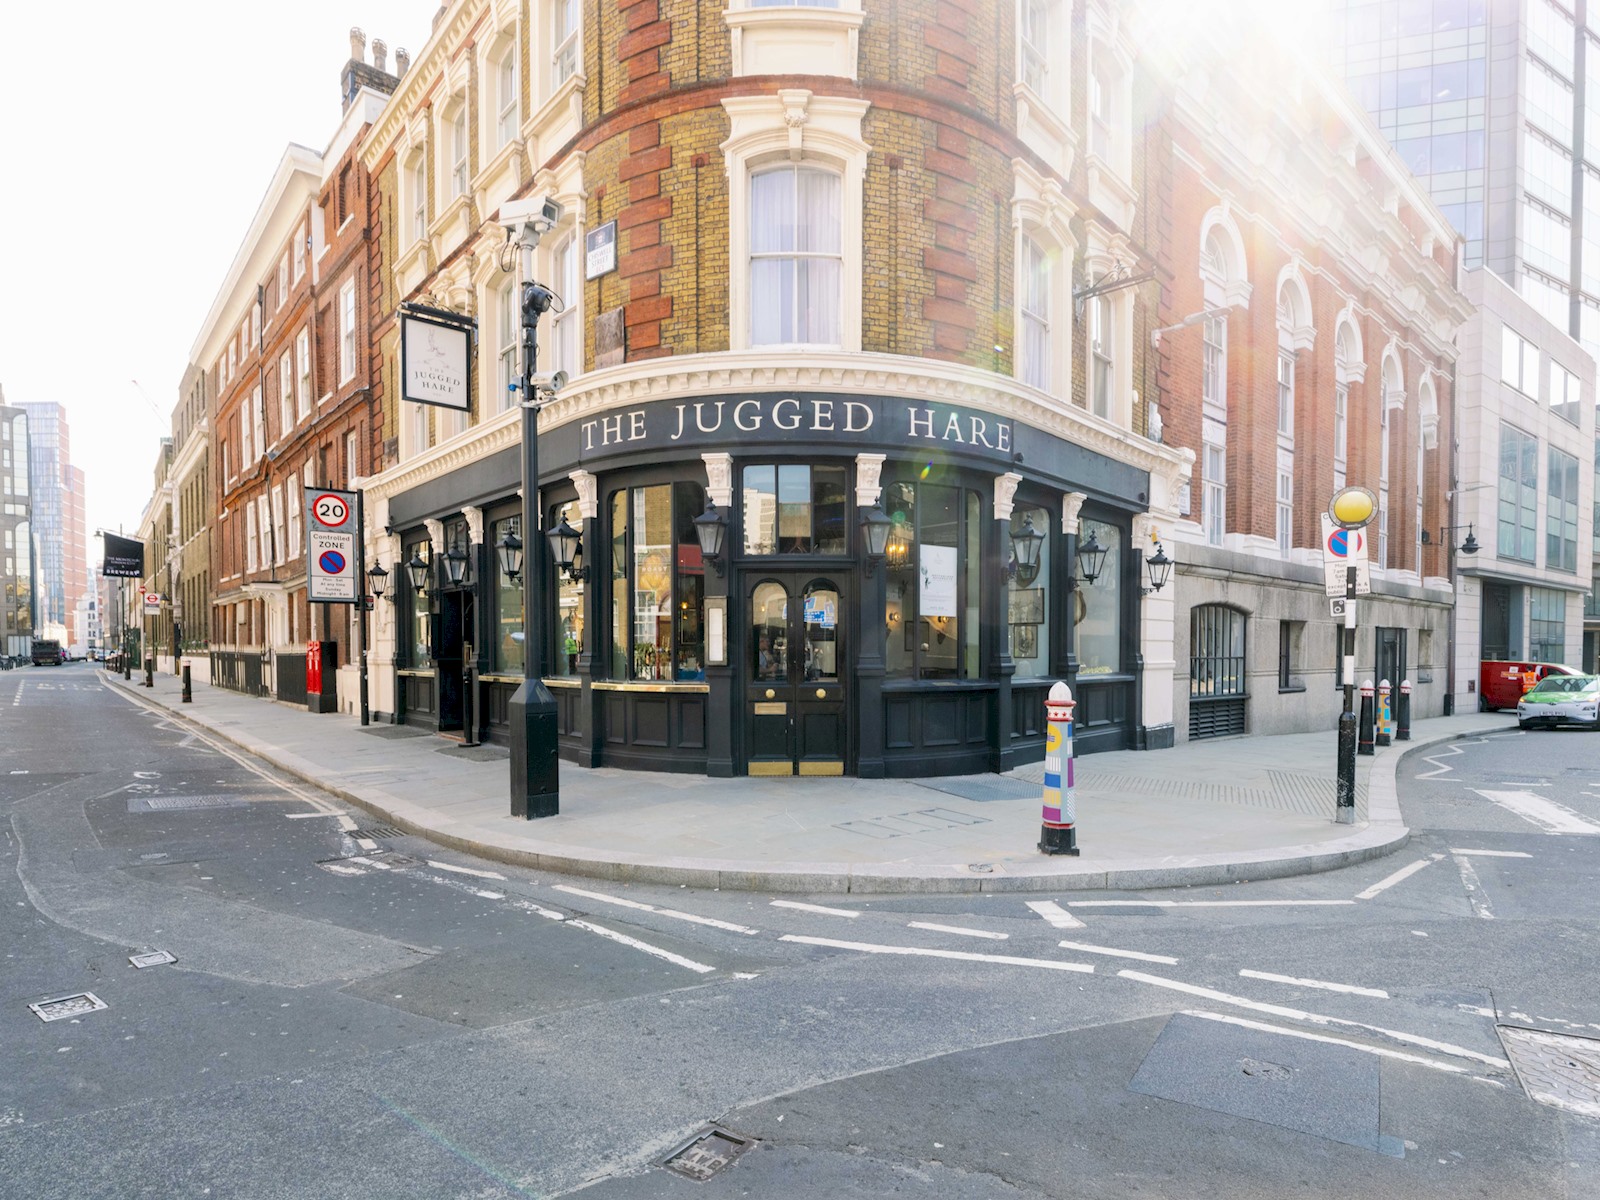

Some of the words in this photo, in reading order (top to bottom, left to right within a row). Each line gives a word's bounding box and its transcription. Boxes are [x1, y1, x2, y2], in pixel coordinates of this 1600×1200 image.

[414, 371, 461, 386] JUGGED
[422, 381, 454, 394] HARE
[581, 411, 647, 451] THE
[670, 398, 874, 440] JUGGED
[907, 407, 1011, 453] HARE
[319, 503, 344, 518] 20
[313, 533, 350, 542] Controlled
[319, 541, 345, 550] ZONE
